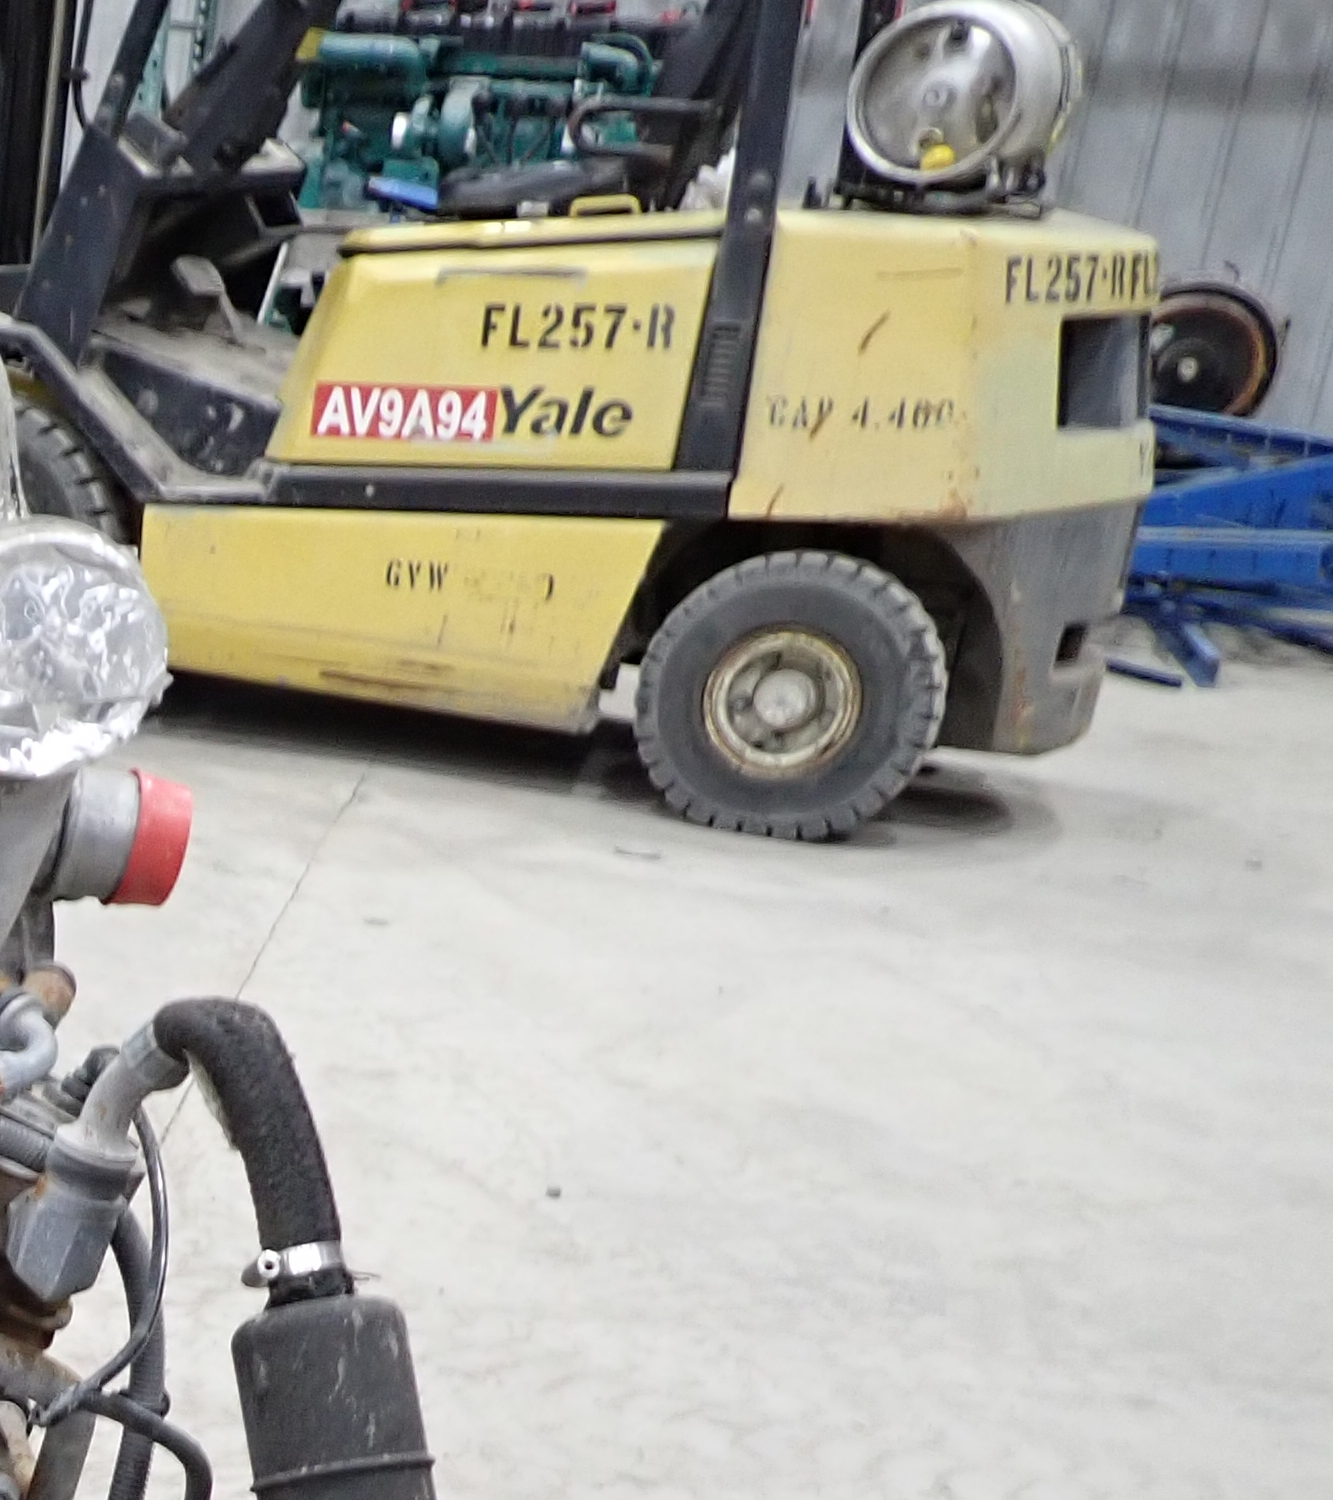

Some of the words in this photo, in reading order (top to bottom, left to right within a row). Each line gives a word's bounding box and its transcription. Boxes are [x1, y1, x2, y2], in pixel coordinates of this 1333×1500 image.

[317, 385, 488, 439] AV9A94
[500, 385, 634, 437] Yale
[386, 558, 449, 590] GVW
